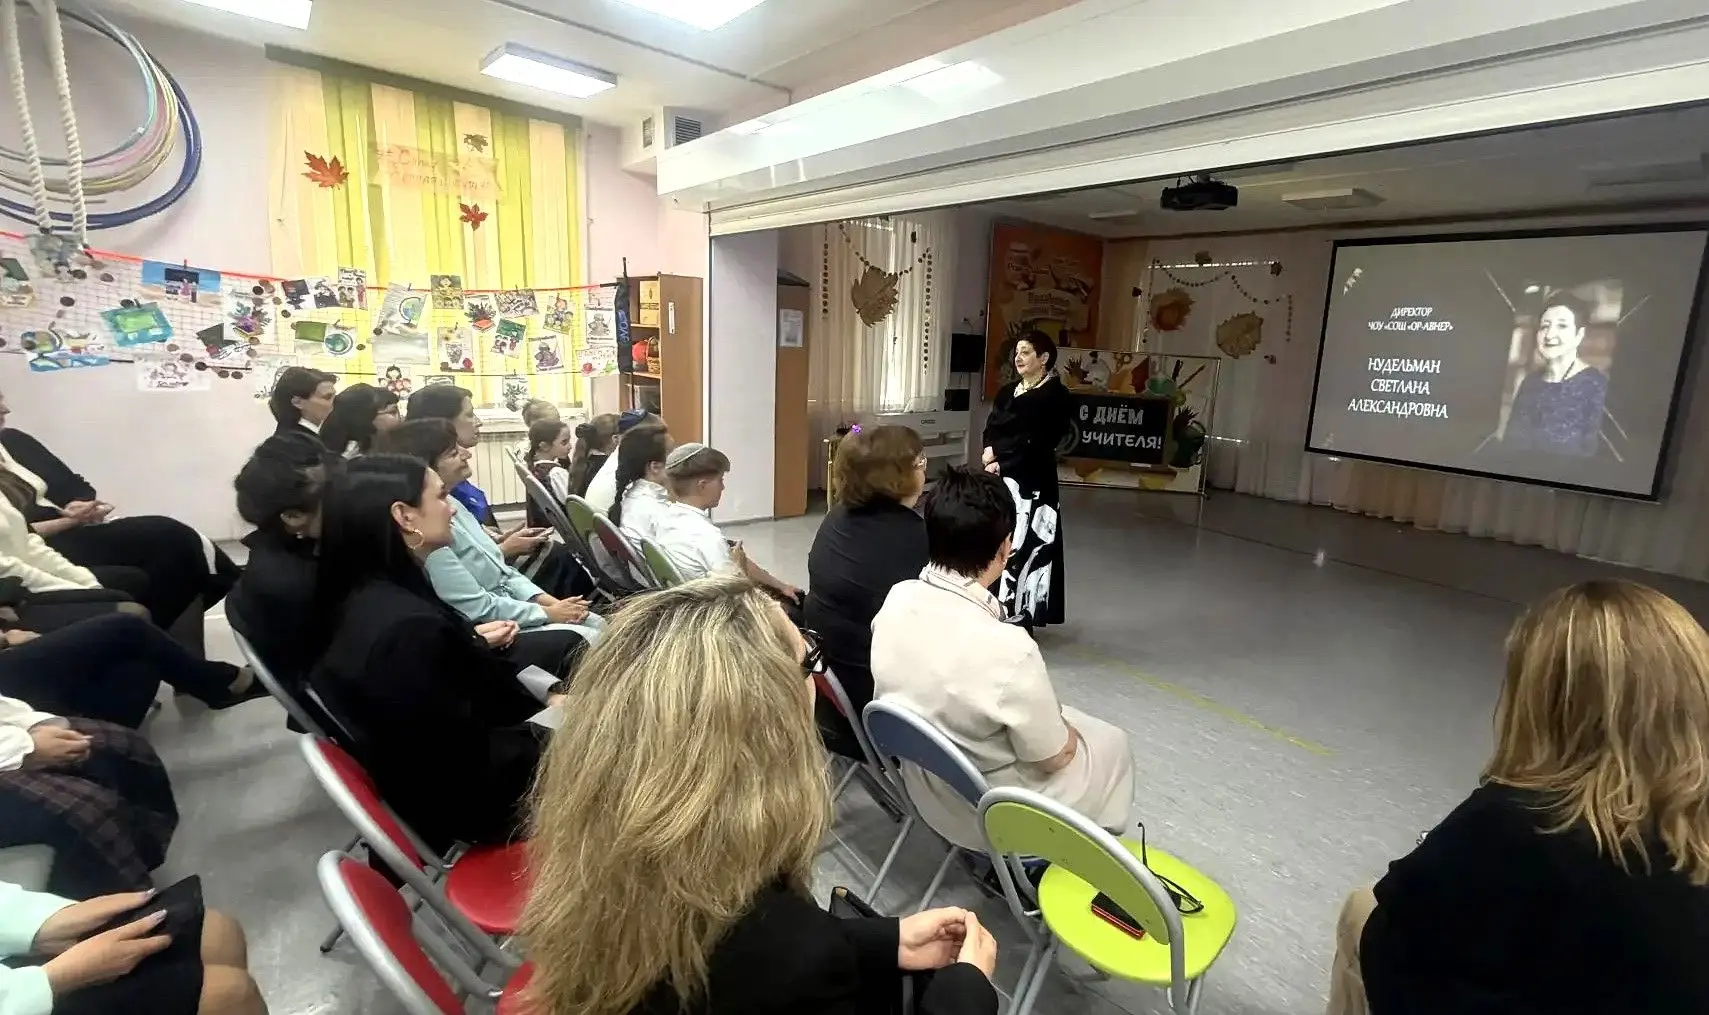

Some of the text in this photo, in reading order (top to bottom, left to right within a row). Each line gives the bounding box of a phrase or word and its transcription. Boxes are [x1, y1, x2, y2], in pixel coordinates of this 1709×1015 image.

[1390, 307, 1433, 319] ДИРЕКТОР
[1367, 321, 1384, 331] ЧОУ
[1367, 357, 1441, 375] НУДЕЛЬМАН
[1370, 378, 1431, 396] СВЕТЛАНА
[1079, 404, 1144, 425] С ДНЁМ
[1347, 398, 1449, 419] АЛЕКСАНДРОВНА
[1081, 430, 1162, 450] УЧИТЕЛЯ!
